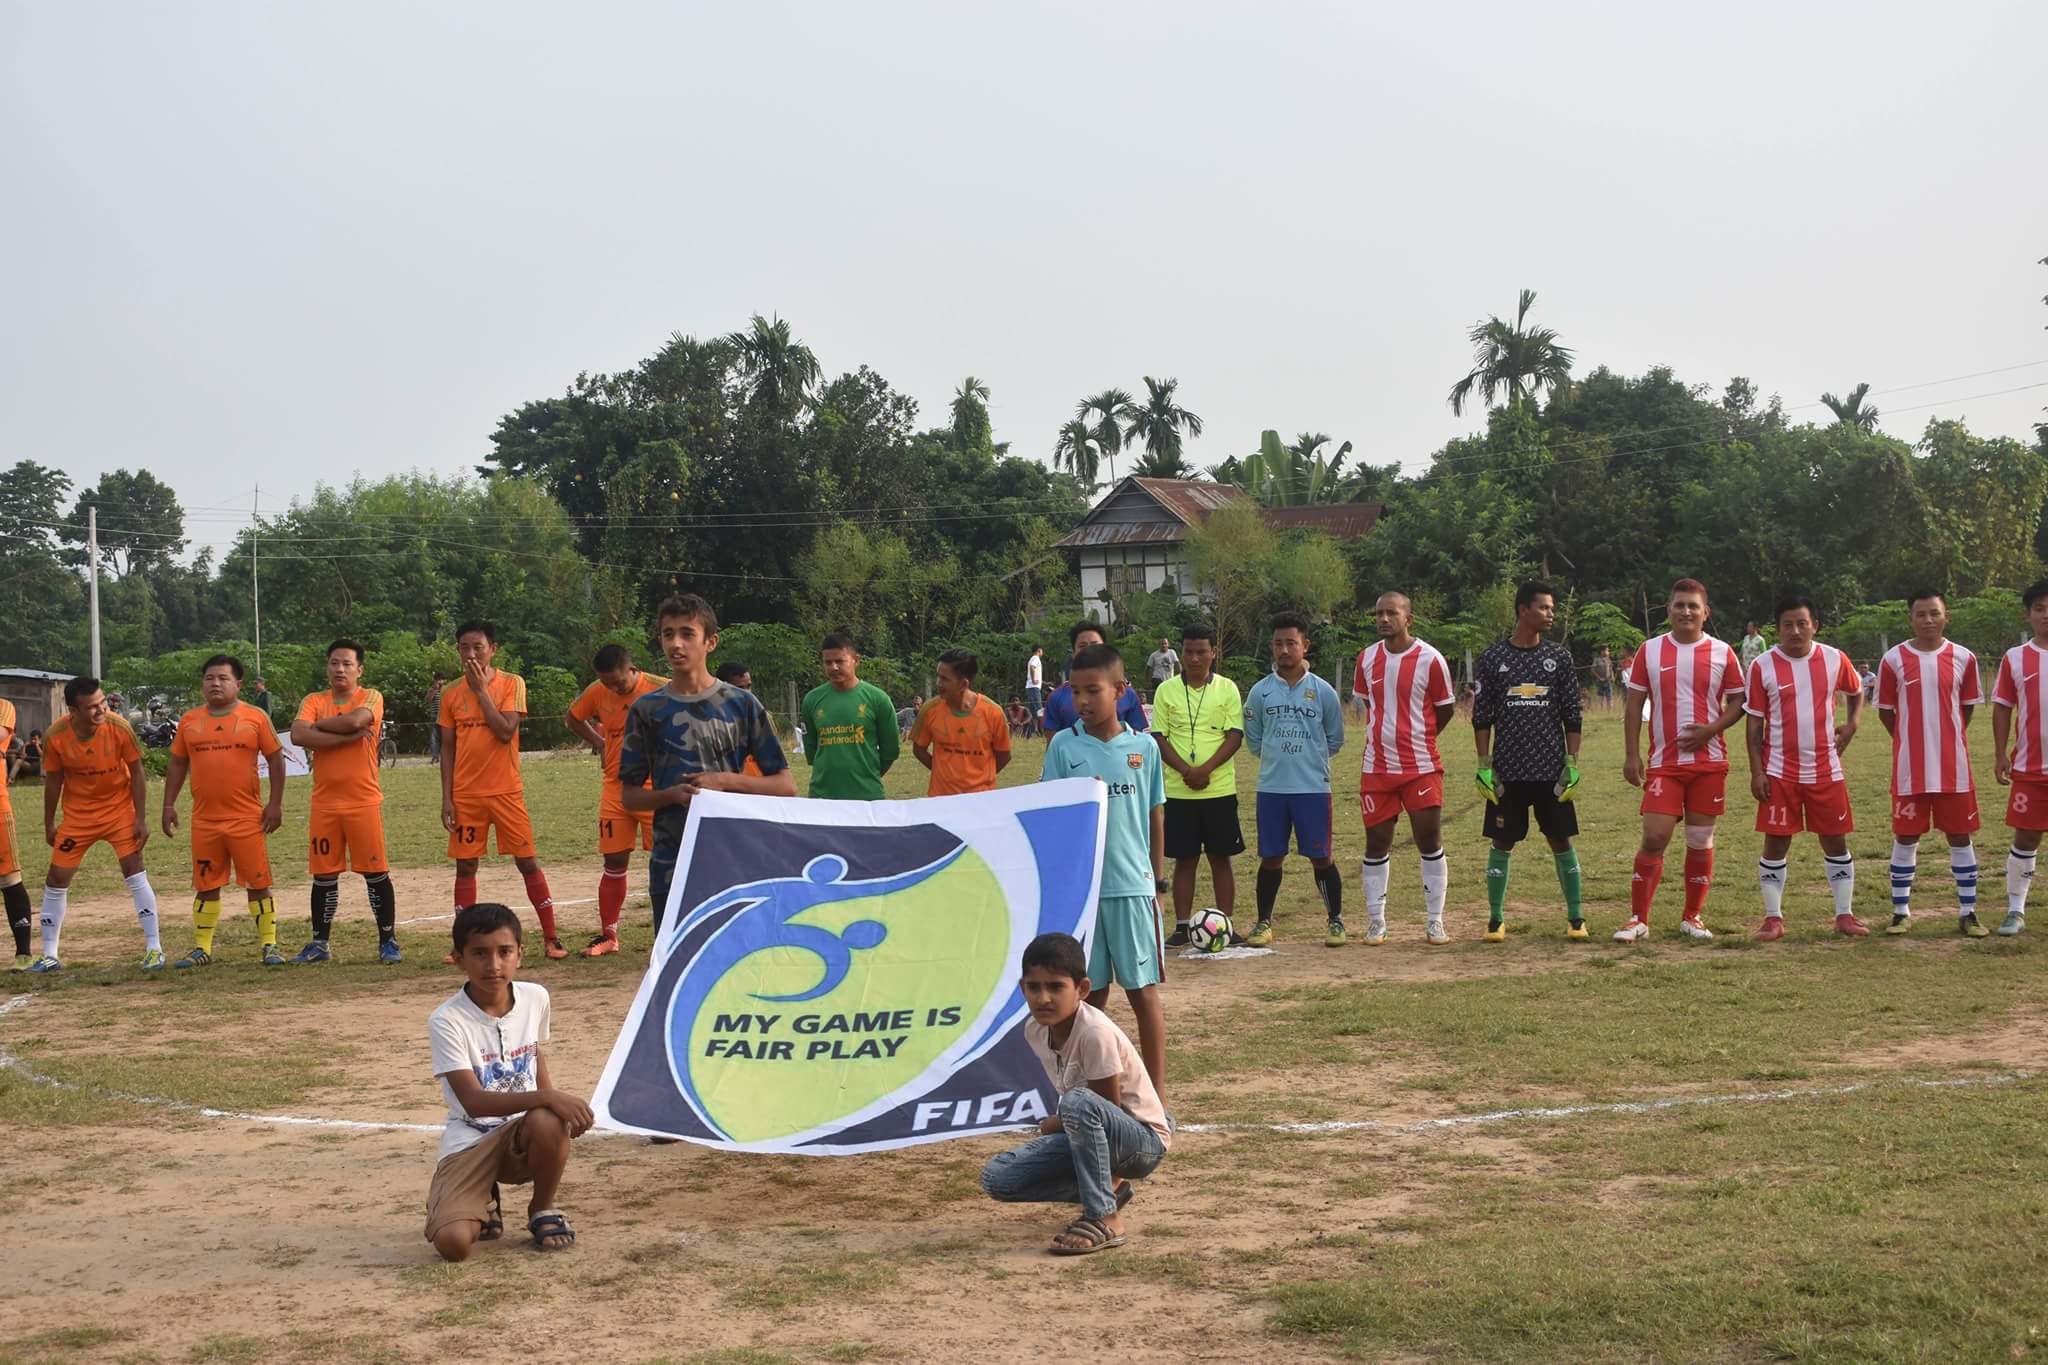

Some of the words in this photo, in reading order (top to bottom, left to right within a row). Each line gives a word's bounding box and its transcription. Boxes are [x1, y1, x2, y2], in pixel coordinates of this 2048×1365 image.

[1266, 704, 1317, 718] ETIHAD
[1281, 741, 1304, 753] Rai
[1648, 777, 1663, 797] 4
[1894, 801, 1917, 819] 14
[2012, 792, 2028, 813] 8
[1768, 805, 1787, 826] 11
[456, 825, 475, 844] 13
[59, 838, 76, 853] 8
[312, 838, 330, 855] 10
[197, 860, 213, 877] 7
[713, 1014, 780, 1034] MY
[792, 1010, 914, 1033] GAME
[925, 1006, 961, 1027] IS
[704, 1039, 794, 1060] FAIR
[805, 1036, 908, 1061] PLAY
[911, 1087, 1049, 1132] FIFA
